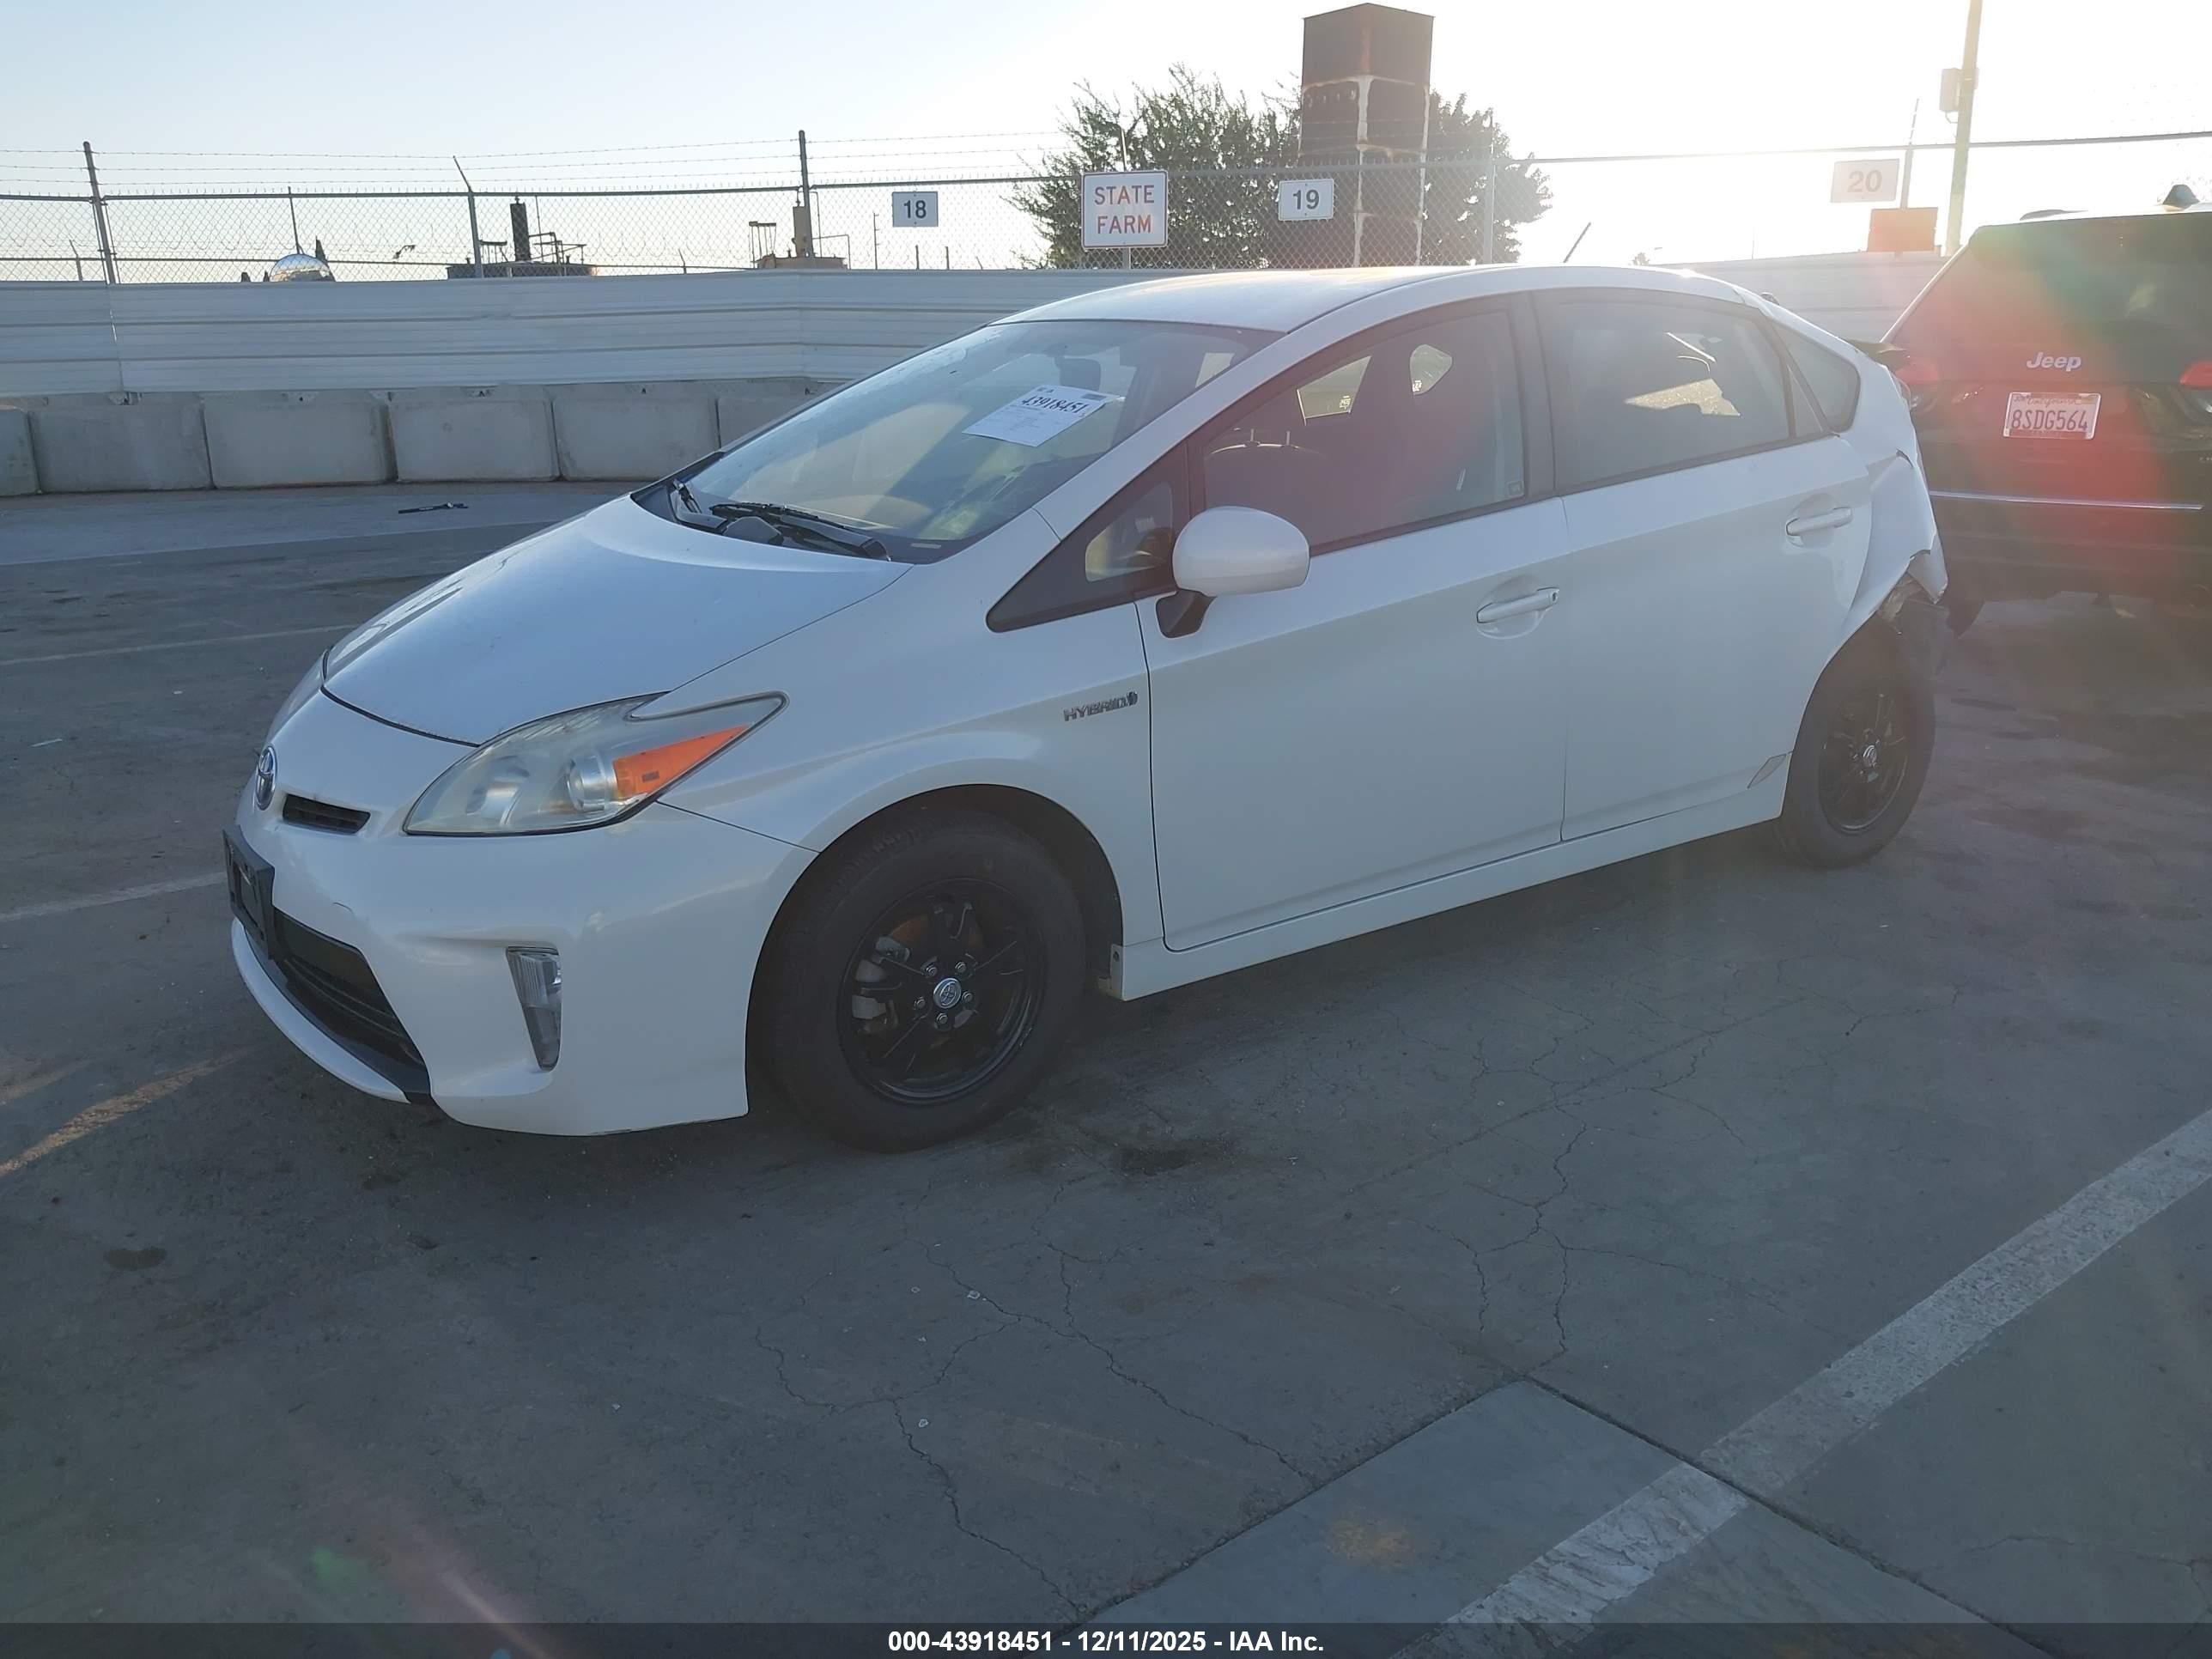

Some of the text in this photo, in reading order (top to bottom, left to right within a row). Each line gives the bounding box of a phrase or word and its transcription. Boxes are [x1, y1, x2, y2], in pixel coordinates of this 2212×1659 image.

[1847, 170, 1882, 192] 20
[1094, 185, 1155, 205] STATE
[1292, 189, 1319, 210] 19
[903, 200, 927, 218] 18
[1097, 215, 1152, 234] FARM
[2027, 351, 2081, 372] Jeep
[1022, 395, 1090, 414] 43918451
[2011, 410, 2088, 431] 8SDG564
[1064, 696, 1128, 721] HYBRID
